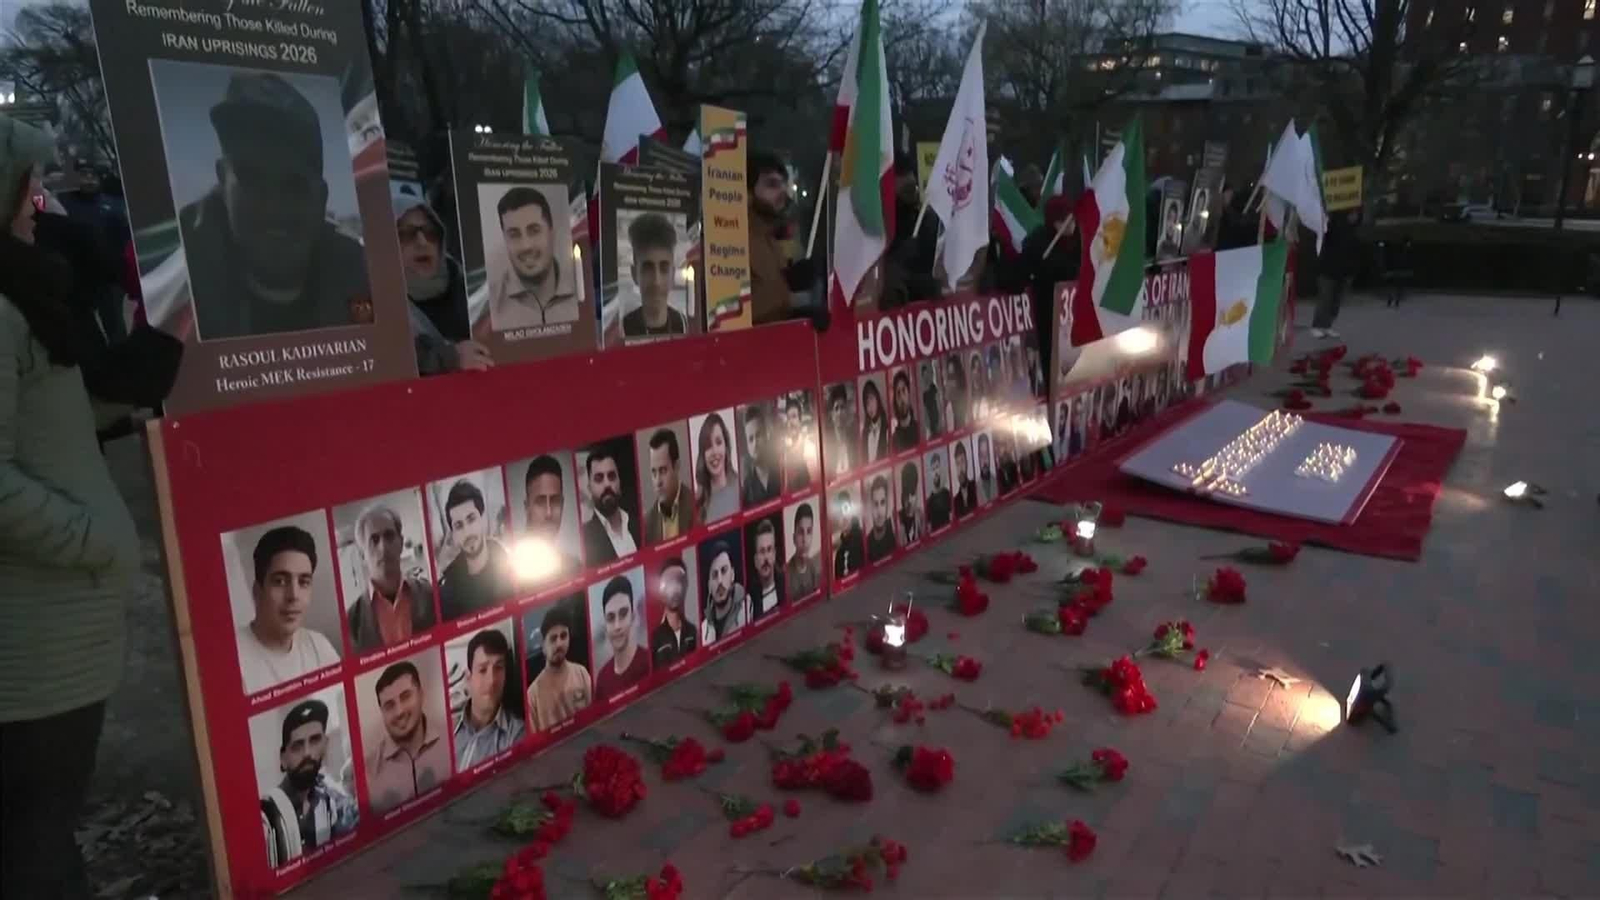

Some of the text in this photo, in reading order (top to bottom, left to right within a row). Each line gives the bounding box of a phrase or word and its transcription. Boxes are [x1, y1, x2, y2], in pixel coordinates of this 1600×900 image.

[126, 0, 222, 31] Remembering
[225, 13, 263, 32] Those
[265, 19, 299, 37] Killed
[300, 22, 337, 45] During
[162, 33, 318, 64] IRAN UPRISINGS 2026
[707, 165, 743, 182] Iranian
[709, 187, 743, 203] People
[714, 216, 739, 230] Want
[709, 243, 746, 259] Regime
[709, 263, 747, 279] Change
[1151, 273, 1168, 306] OF
[1168, 272, 1190, 301] IRAN
[857, 293, 1034, 371] HONORING OVER
[219, 338, 368, 370] RASOUL KADIVARIAN
[215, 375, 258, 393] Heroic
[261, 369, 294, 387] MEK
[296, 364, 354, 381] Resistance
[362, 358, 375, 373] 17
